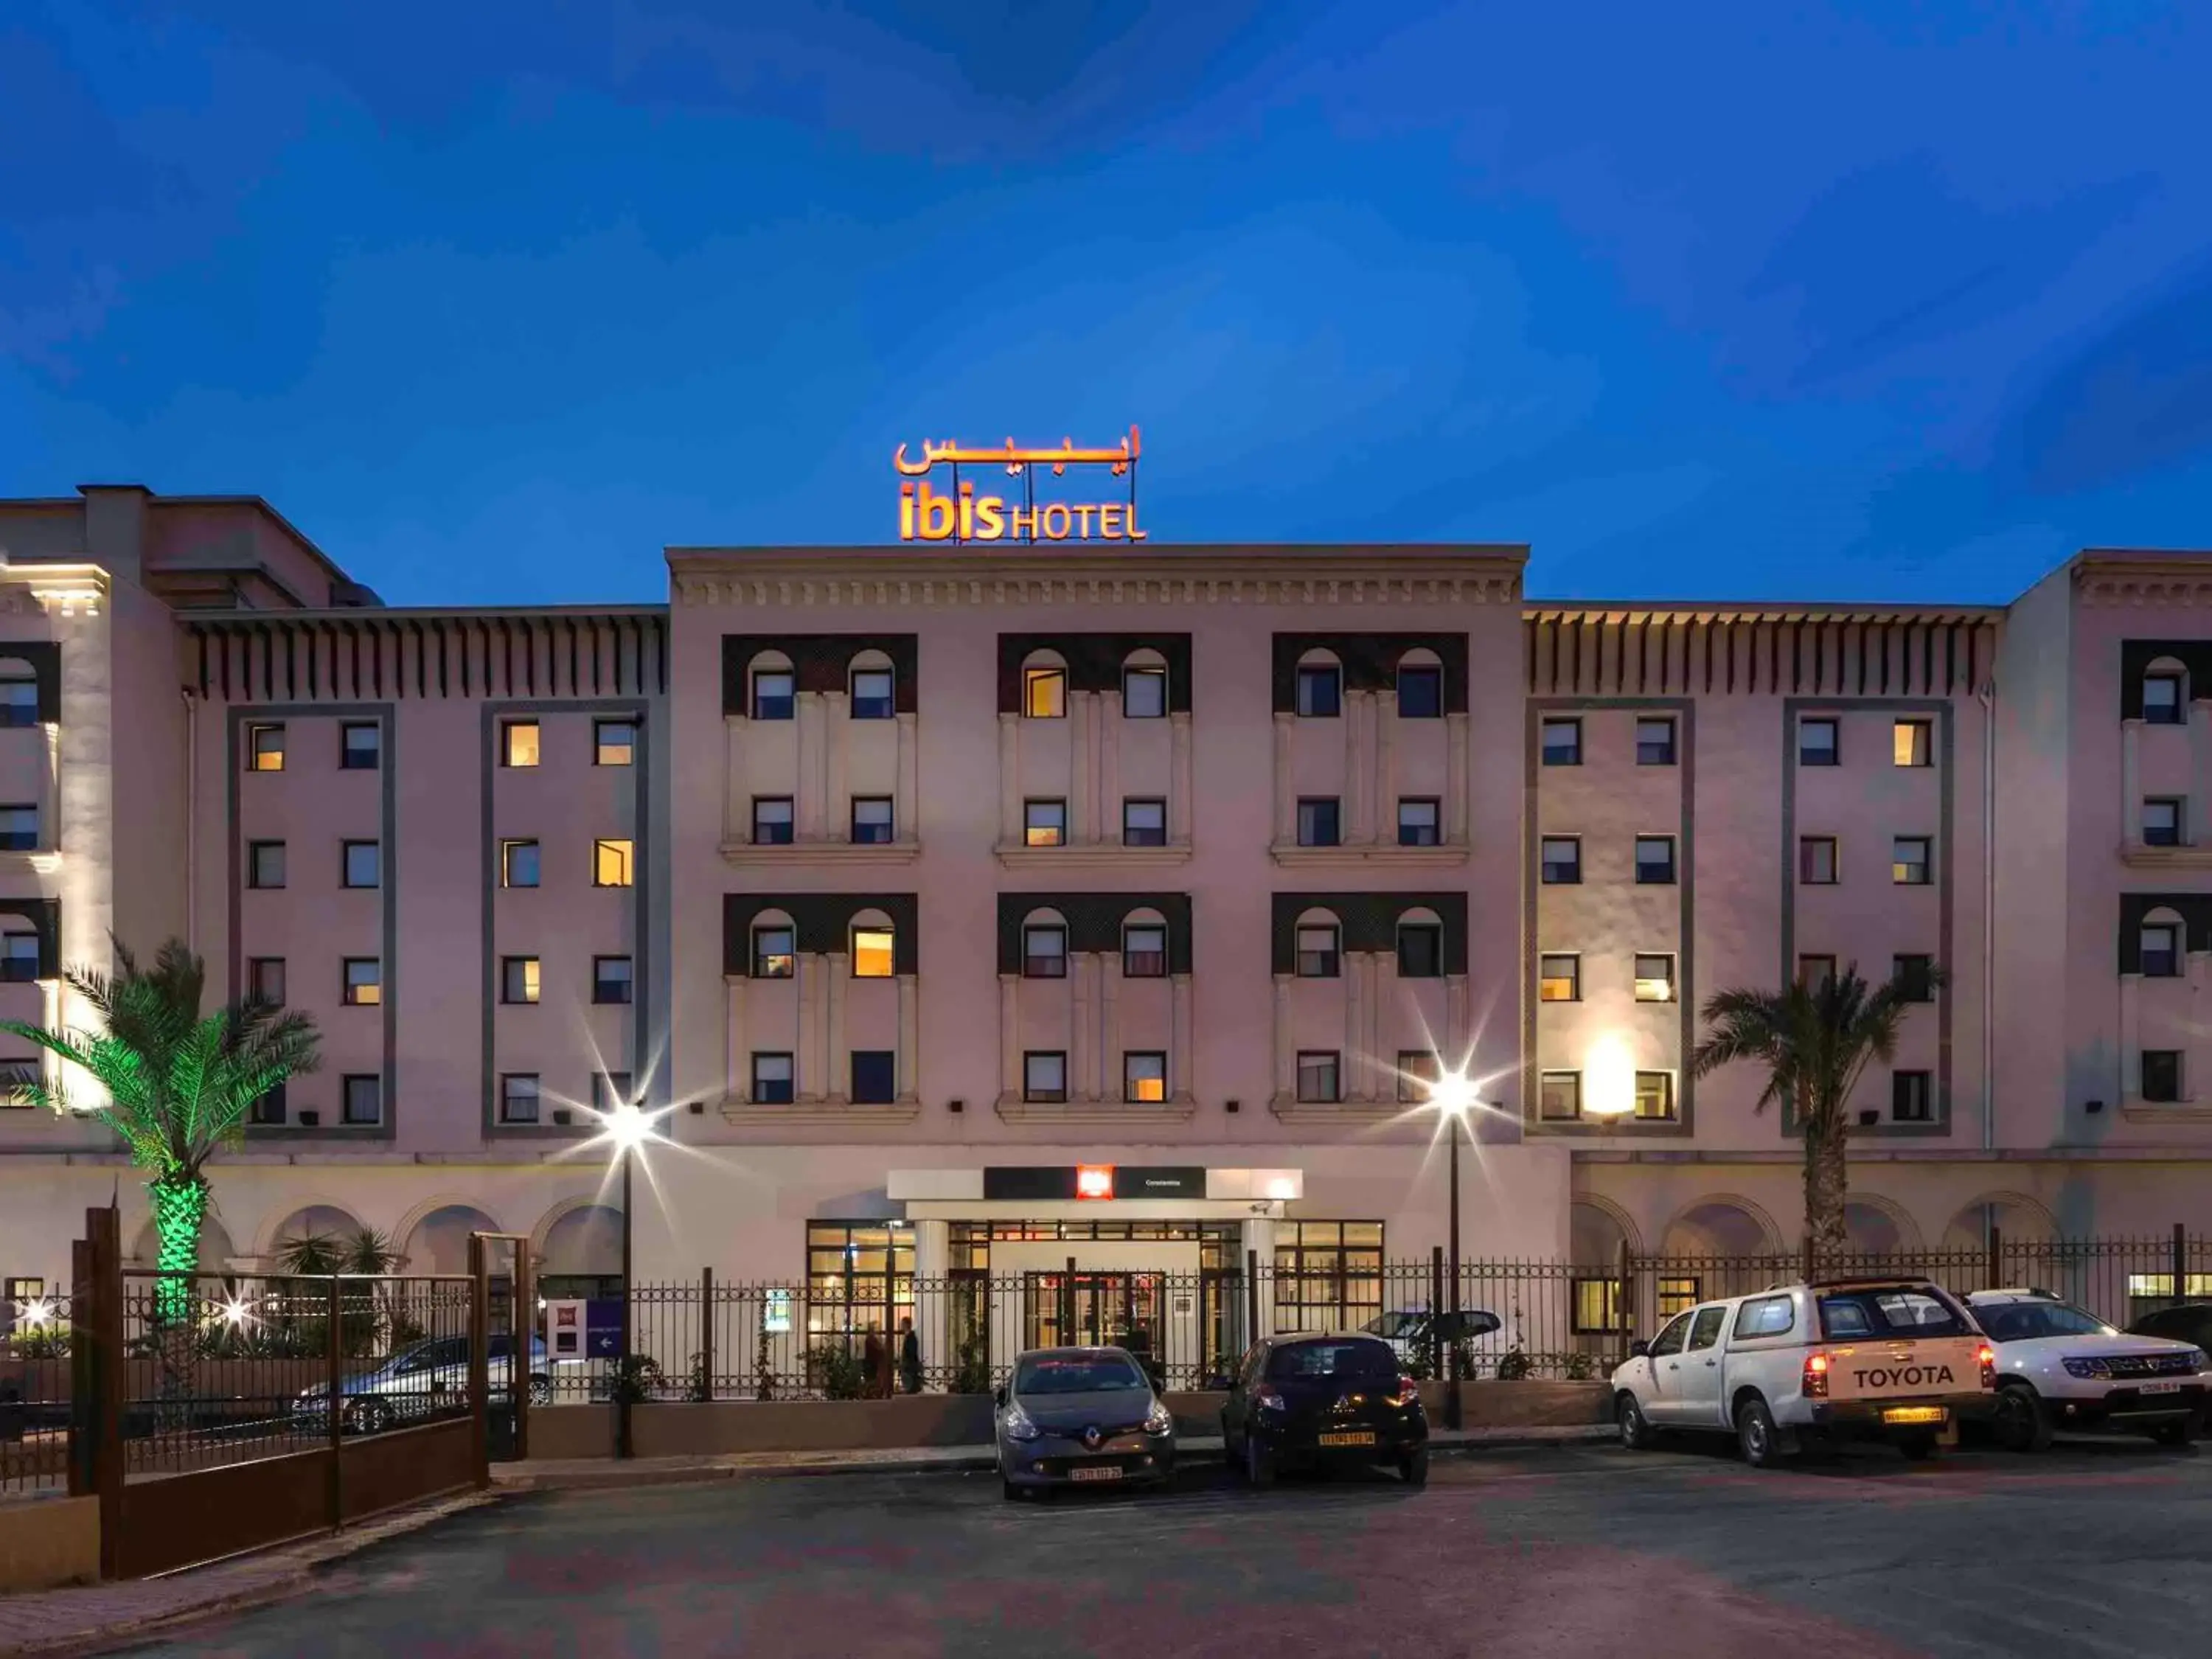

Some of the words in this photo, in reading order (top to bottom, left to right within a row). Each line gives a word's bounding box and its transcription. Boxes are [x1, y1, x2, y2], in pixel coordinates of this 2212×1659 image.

[900, 481, 1004, 540] ibis
[1012, 504, 1147, 540] HOTEL
[1854, 1366, 1954, 1388] TOYOTA
